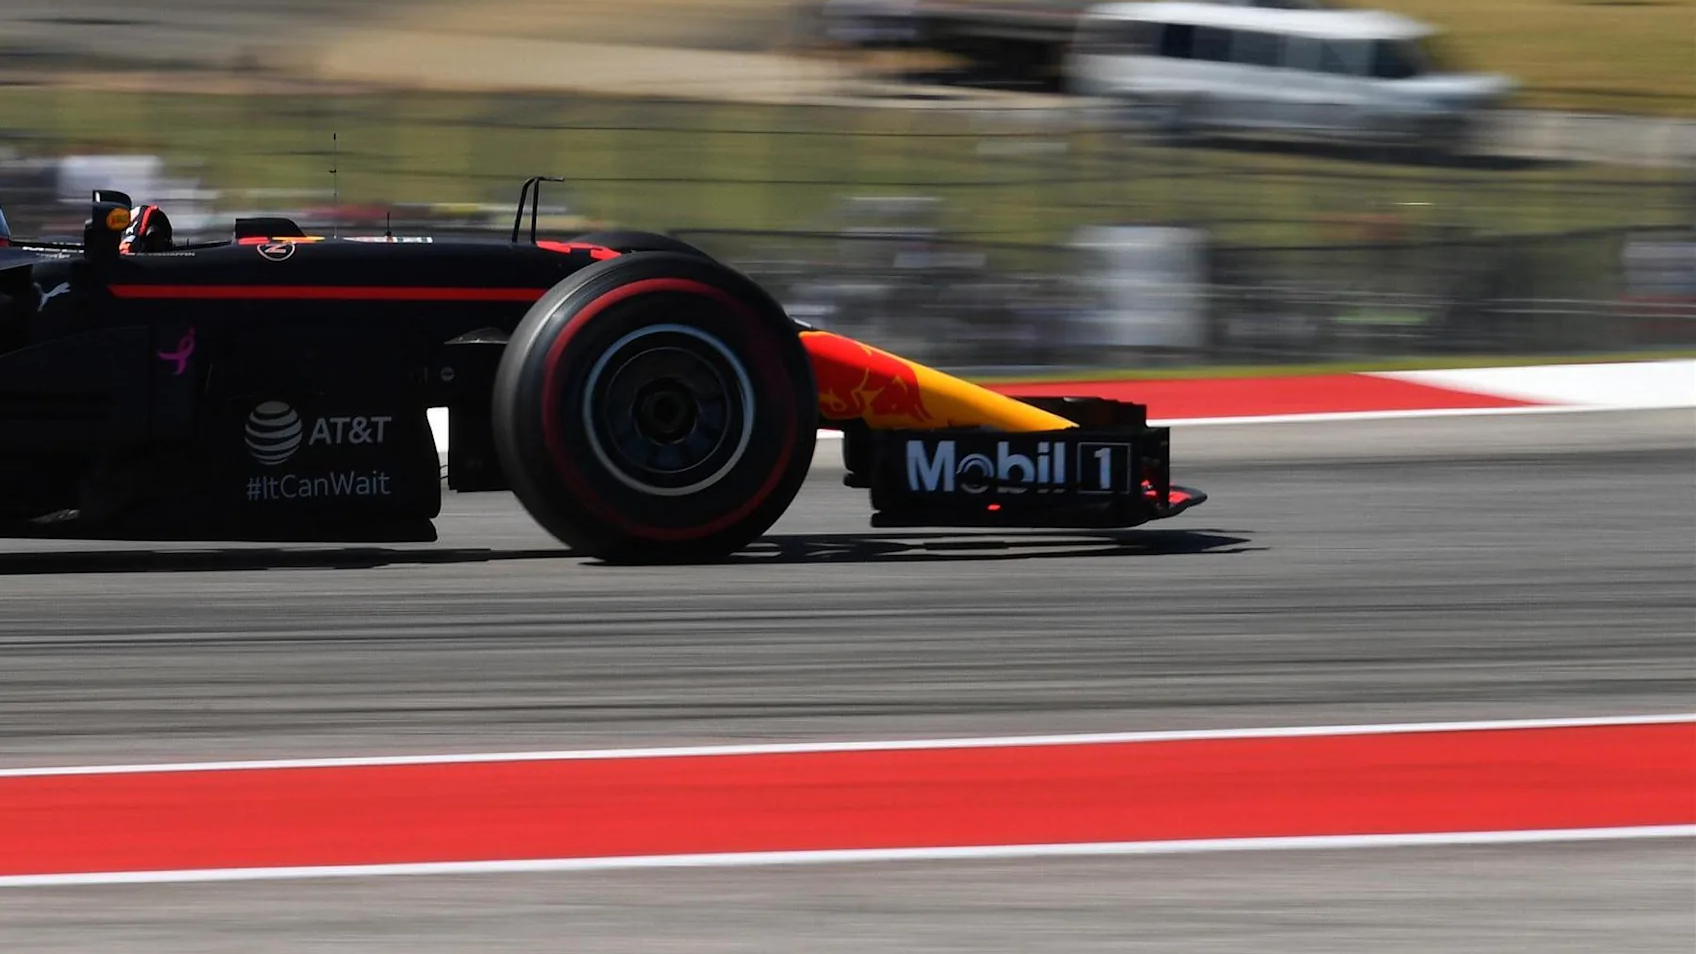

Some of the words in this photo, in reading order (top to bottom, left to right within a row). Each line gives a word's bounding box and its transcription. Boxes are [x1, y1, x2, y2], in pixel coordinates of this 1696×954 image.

[309, 416, 392, 445] AT&T
[906, 440, 1067, 495] Mobil
[1093, 447, 1112, 490] 1
[246, 470, 392, 502] #ItCanWait
